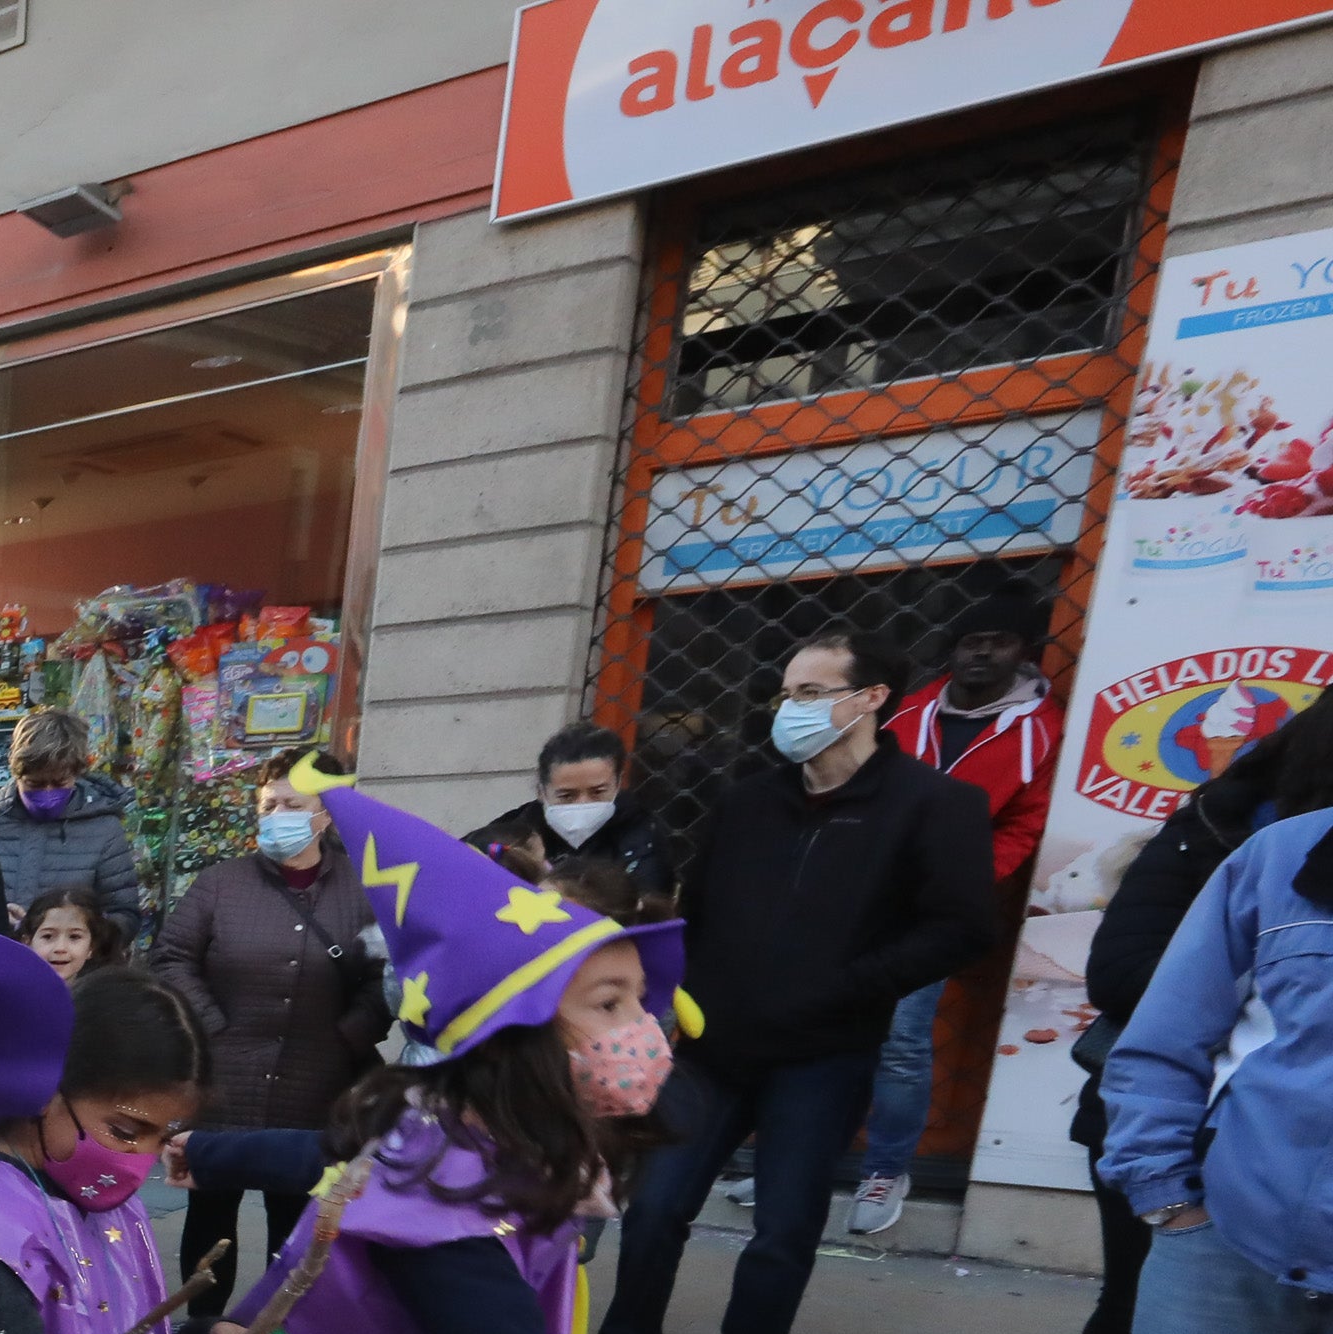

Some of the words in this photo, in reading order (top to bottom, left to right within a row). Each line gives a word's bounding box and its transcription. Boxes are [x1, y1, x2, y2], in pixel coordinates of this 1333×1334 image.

[619, 0, 1065, 117] alaça
[1191, 269, 1261, 307] Tu
[1234, 300, 1321, 325] FROZEN
[679, 483, 759, 528] Tu
[800, 443, 1056, 513] YOGUR
[734, 532, 834, 561] FROZEN
[849, 515, 971, 547] YOGURT
[1255, 560, 1286, 579] Tu
[1099, 648, 1297, 714] HELADOS
[1301, 653, 1333, 686] L
